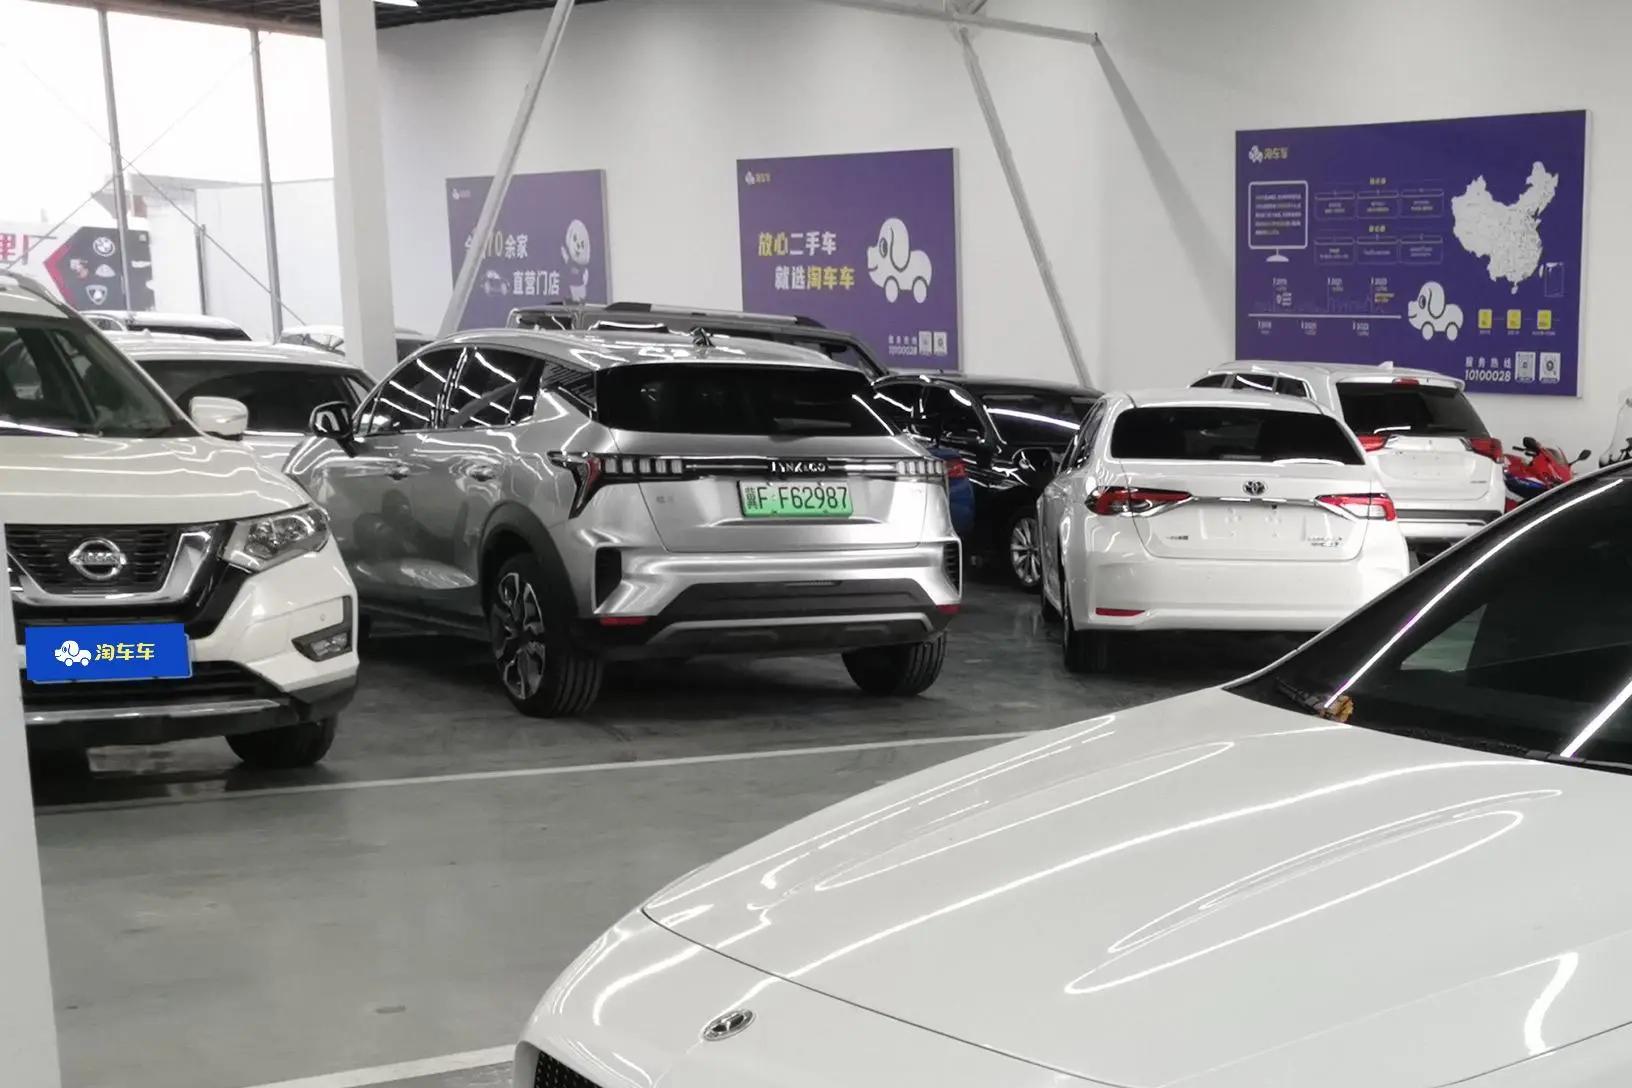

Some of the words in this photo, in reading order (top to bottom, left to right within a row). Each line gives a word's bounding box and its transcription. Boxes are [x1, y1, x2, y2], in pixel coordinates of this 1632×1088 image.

[757, 231, 837, 256] 放心二手车
[512, 270, 561, 296] 直营门店
[774, 266, 856, 291] 就选淘车车
[95, 642, 155, 661] 淘车车
